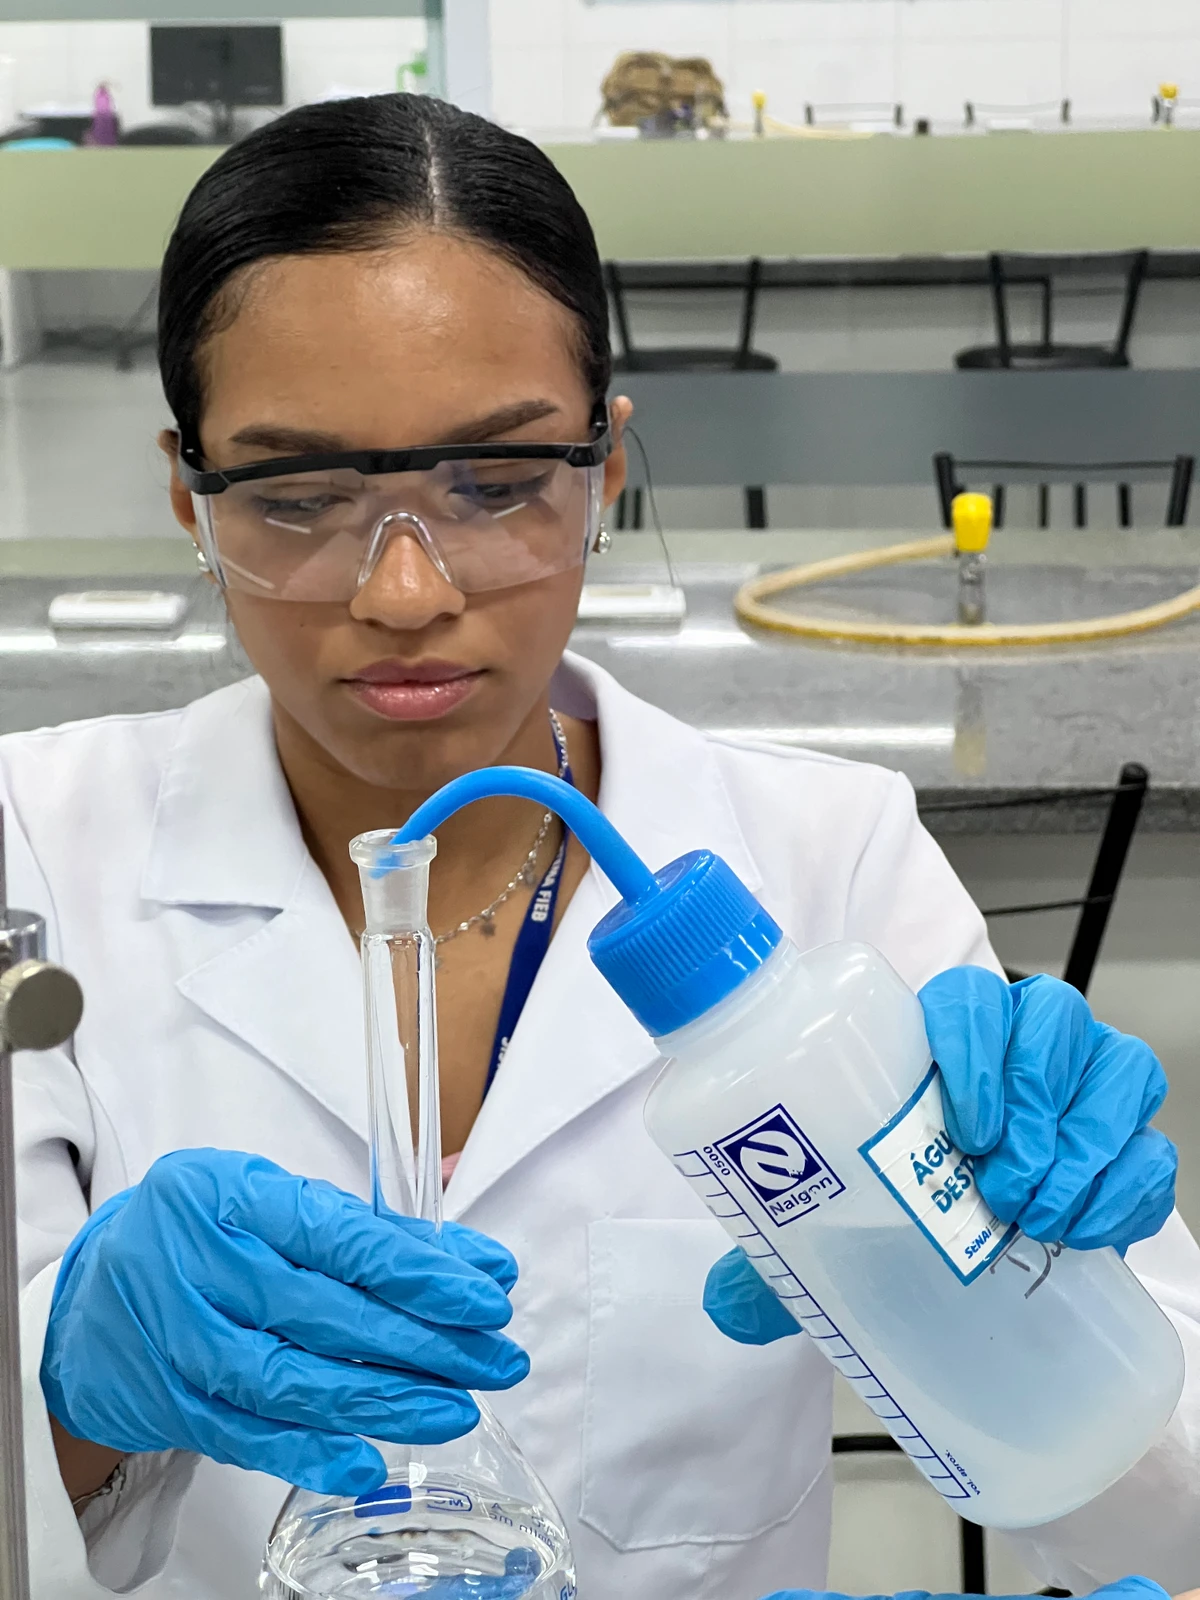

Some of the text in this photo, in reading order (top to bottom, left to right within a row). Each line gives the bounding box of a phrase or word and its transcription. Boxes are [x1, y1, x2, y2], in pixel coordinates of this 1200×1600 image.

[531, 890, 552, 922] FIEB
[702, 1145, 731, 1176] 0500
[964, 1226, 992, 1259] SENAI
[945, 1449, 981, 1496] vol. aprox.
